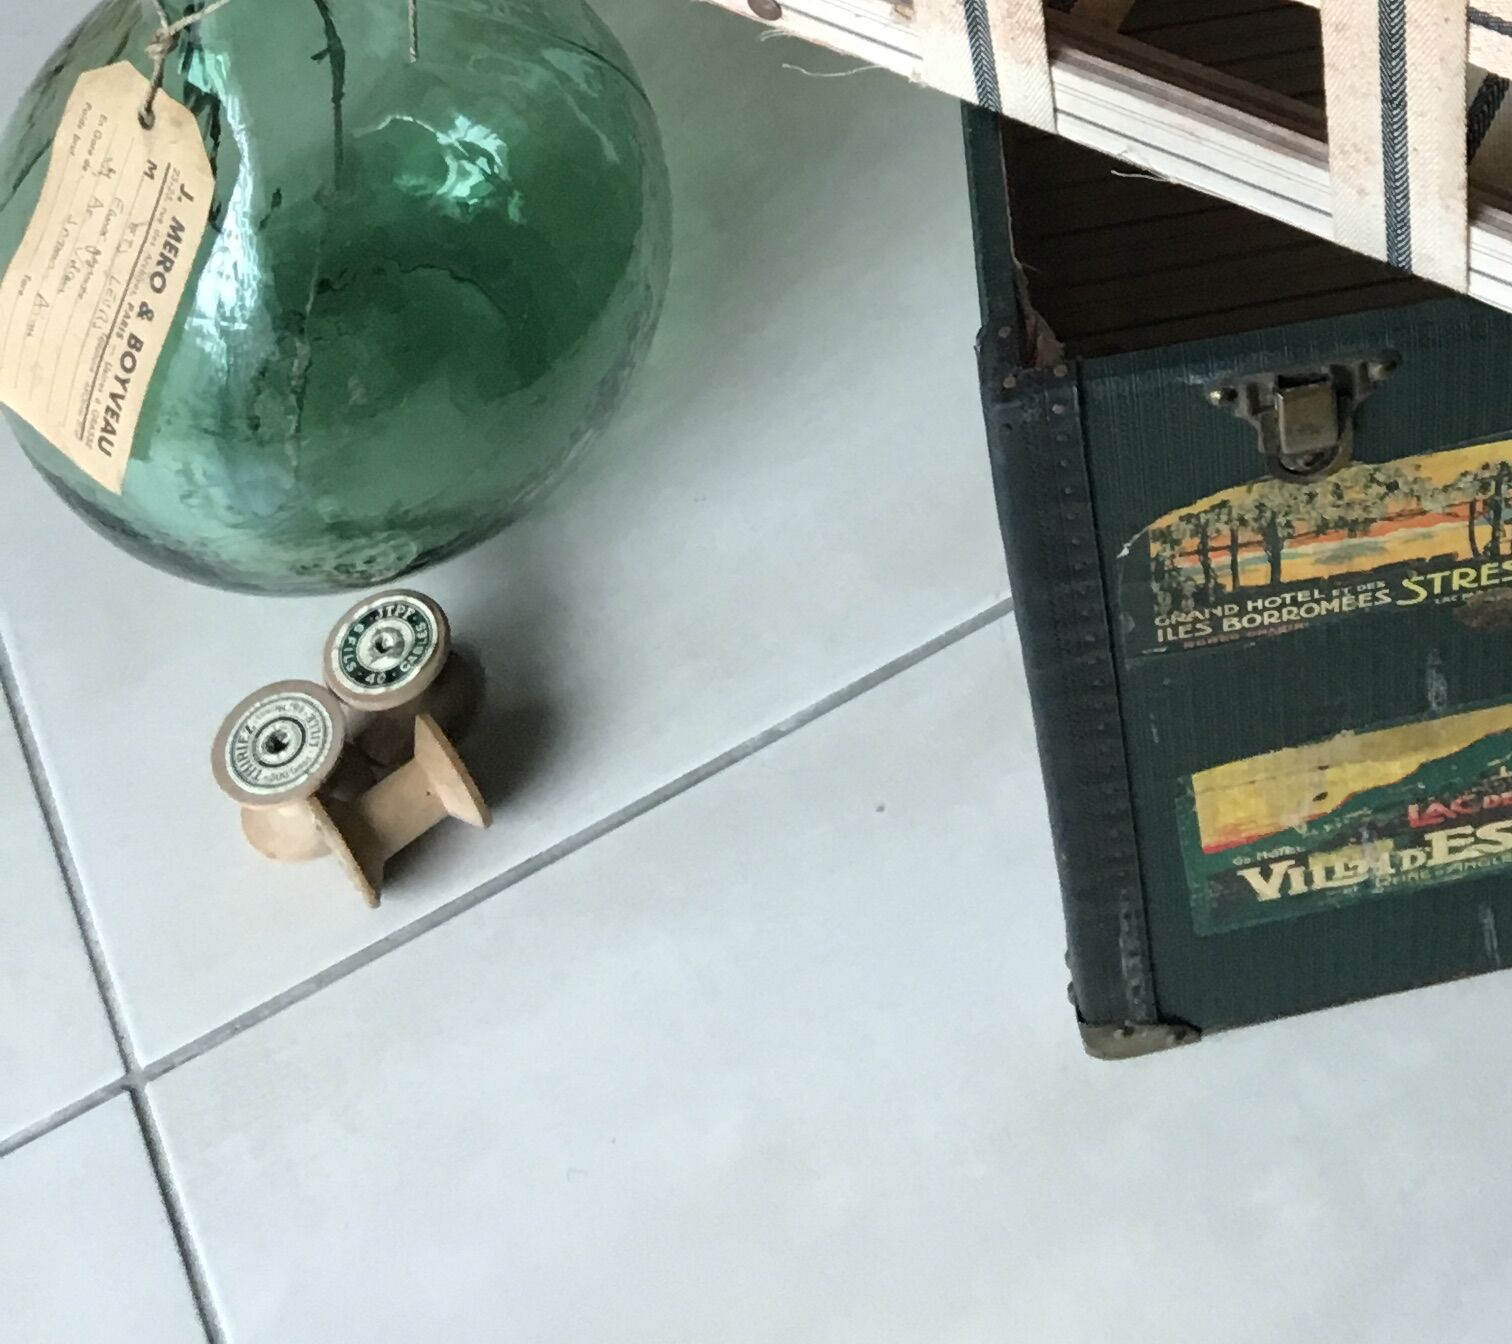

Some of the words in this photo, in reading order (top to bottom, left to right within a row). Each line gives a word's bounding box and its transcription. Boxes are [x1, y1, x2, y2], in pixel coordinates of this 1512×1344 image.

[178, 183, 195, 203] J.
[149, 215, 186, 295] MERO
[116, 301, 135, 340] PARIS
[137, 301, 155, 322] &
[97, 333, 144, 458] BOYVEAU
[1154, 602, 1239, 627] GRAND
[1246, 589, 1326, 611] HOTEL
[1156, 619, 1212, 643] ILES
[343, 636, 356, 672] FILS
[364, 672, 386, 683] 40
[1407, 794, 1476, 828] LAC
